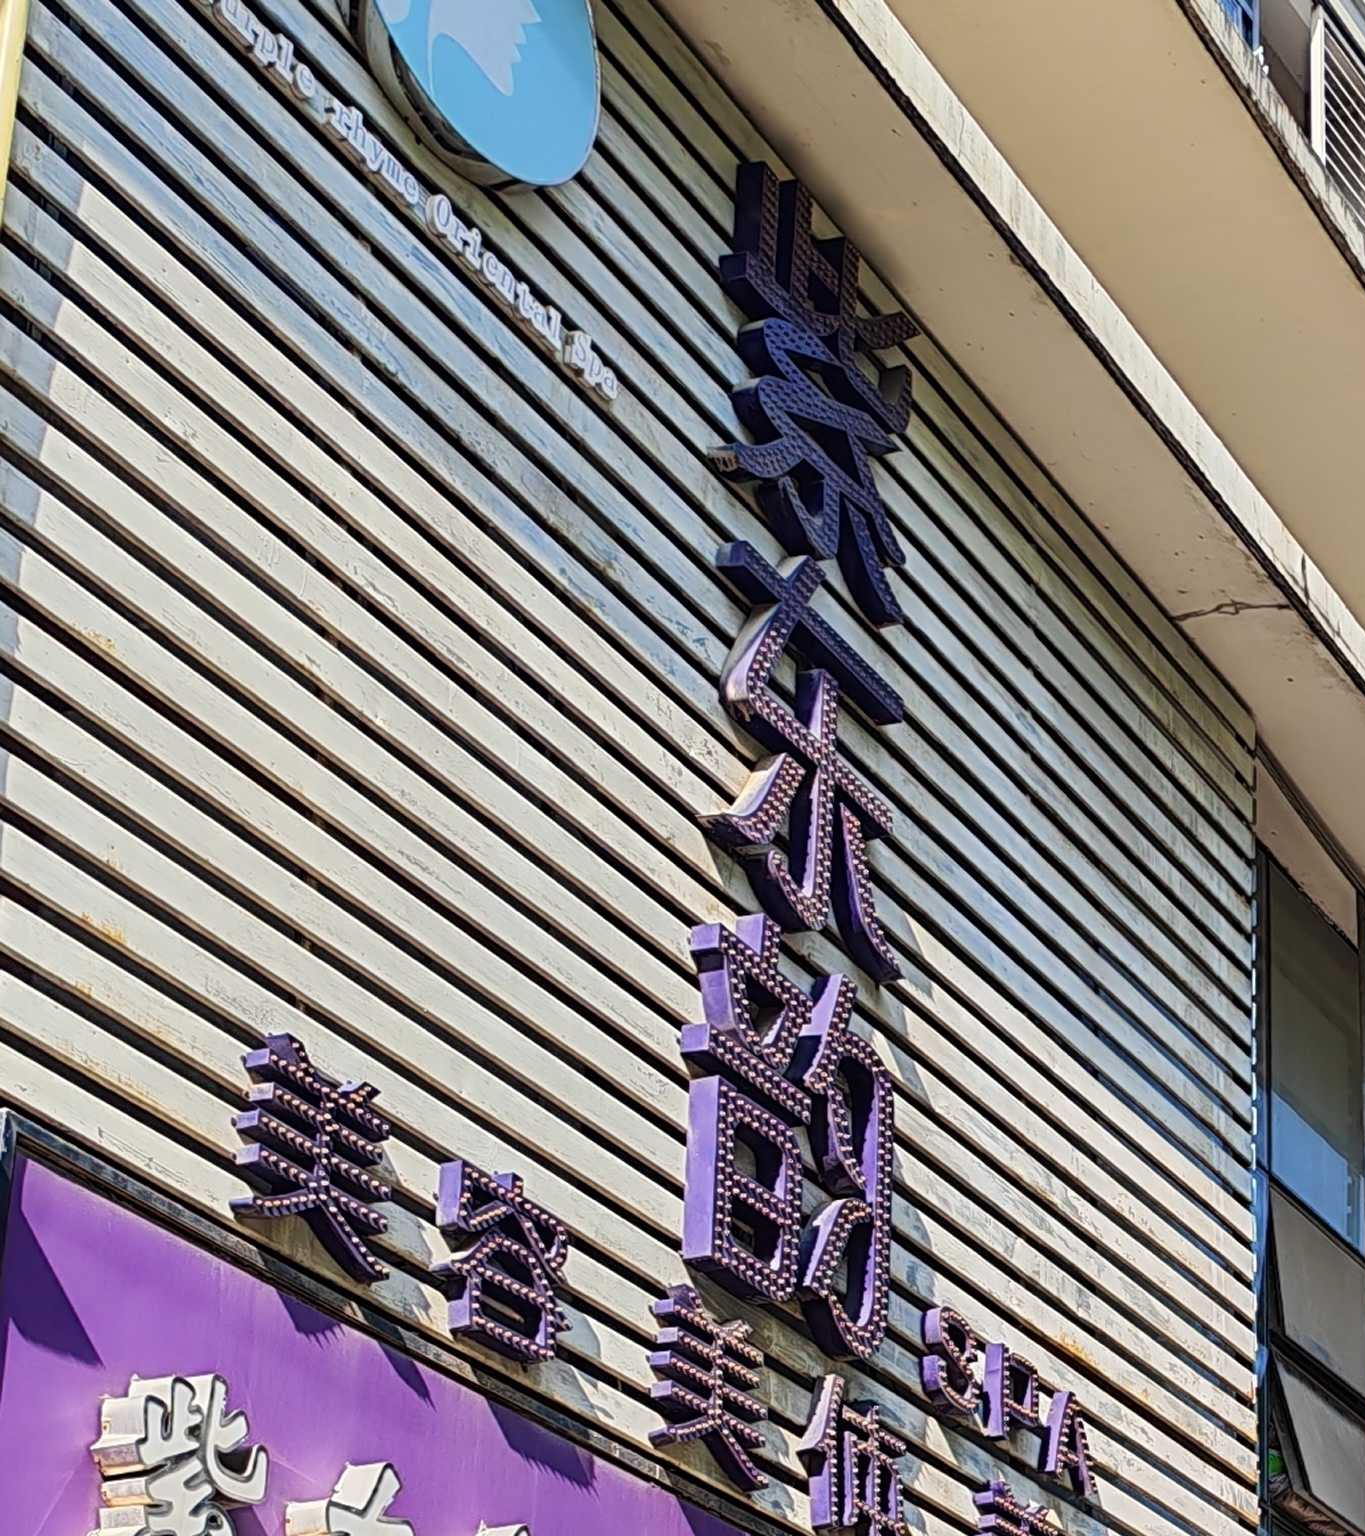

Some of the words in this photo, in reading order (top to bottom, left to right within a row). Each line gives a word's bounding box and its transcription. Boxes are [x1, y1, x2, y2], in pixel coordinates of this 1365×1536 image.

[425, 194, 562, 350] Oriental
[564, 330, 619, 400] Spa
[921, 1306, 1098, 1498] SPA
